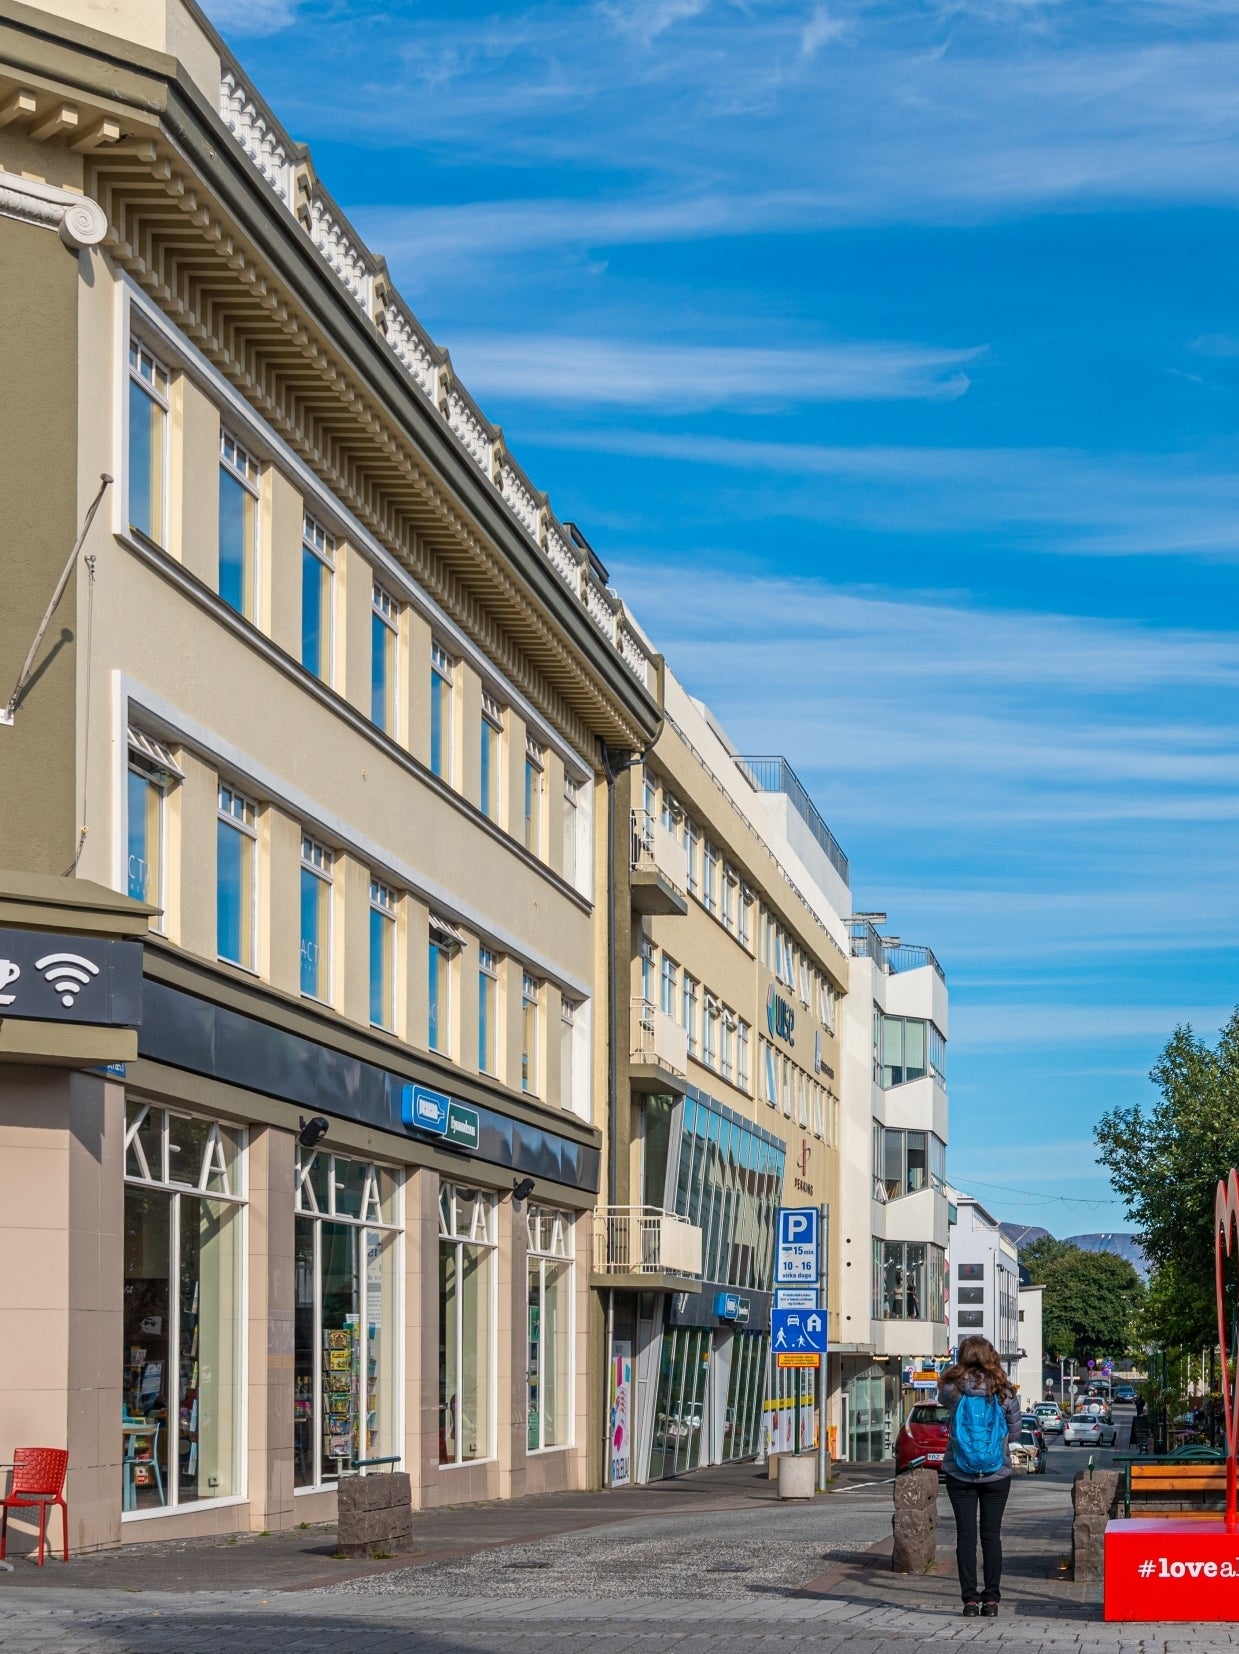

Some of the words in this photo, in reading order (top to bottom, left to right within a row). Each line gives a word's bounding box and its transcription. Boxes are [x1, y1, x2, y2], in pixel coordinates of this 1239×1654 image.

[793, 1246, 804, 1255] 15
[783, 1261, 793, 1271] 10
[801, 1261, 812, 1271] 16
